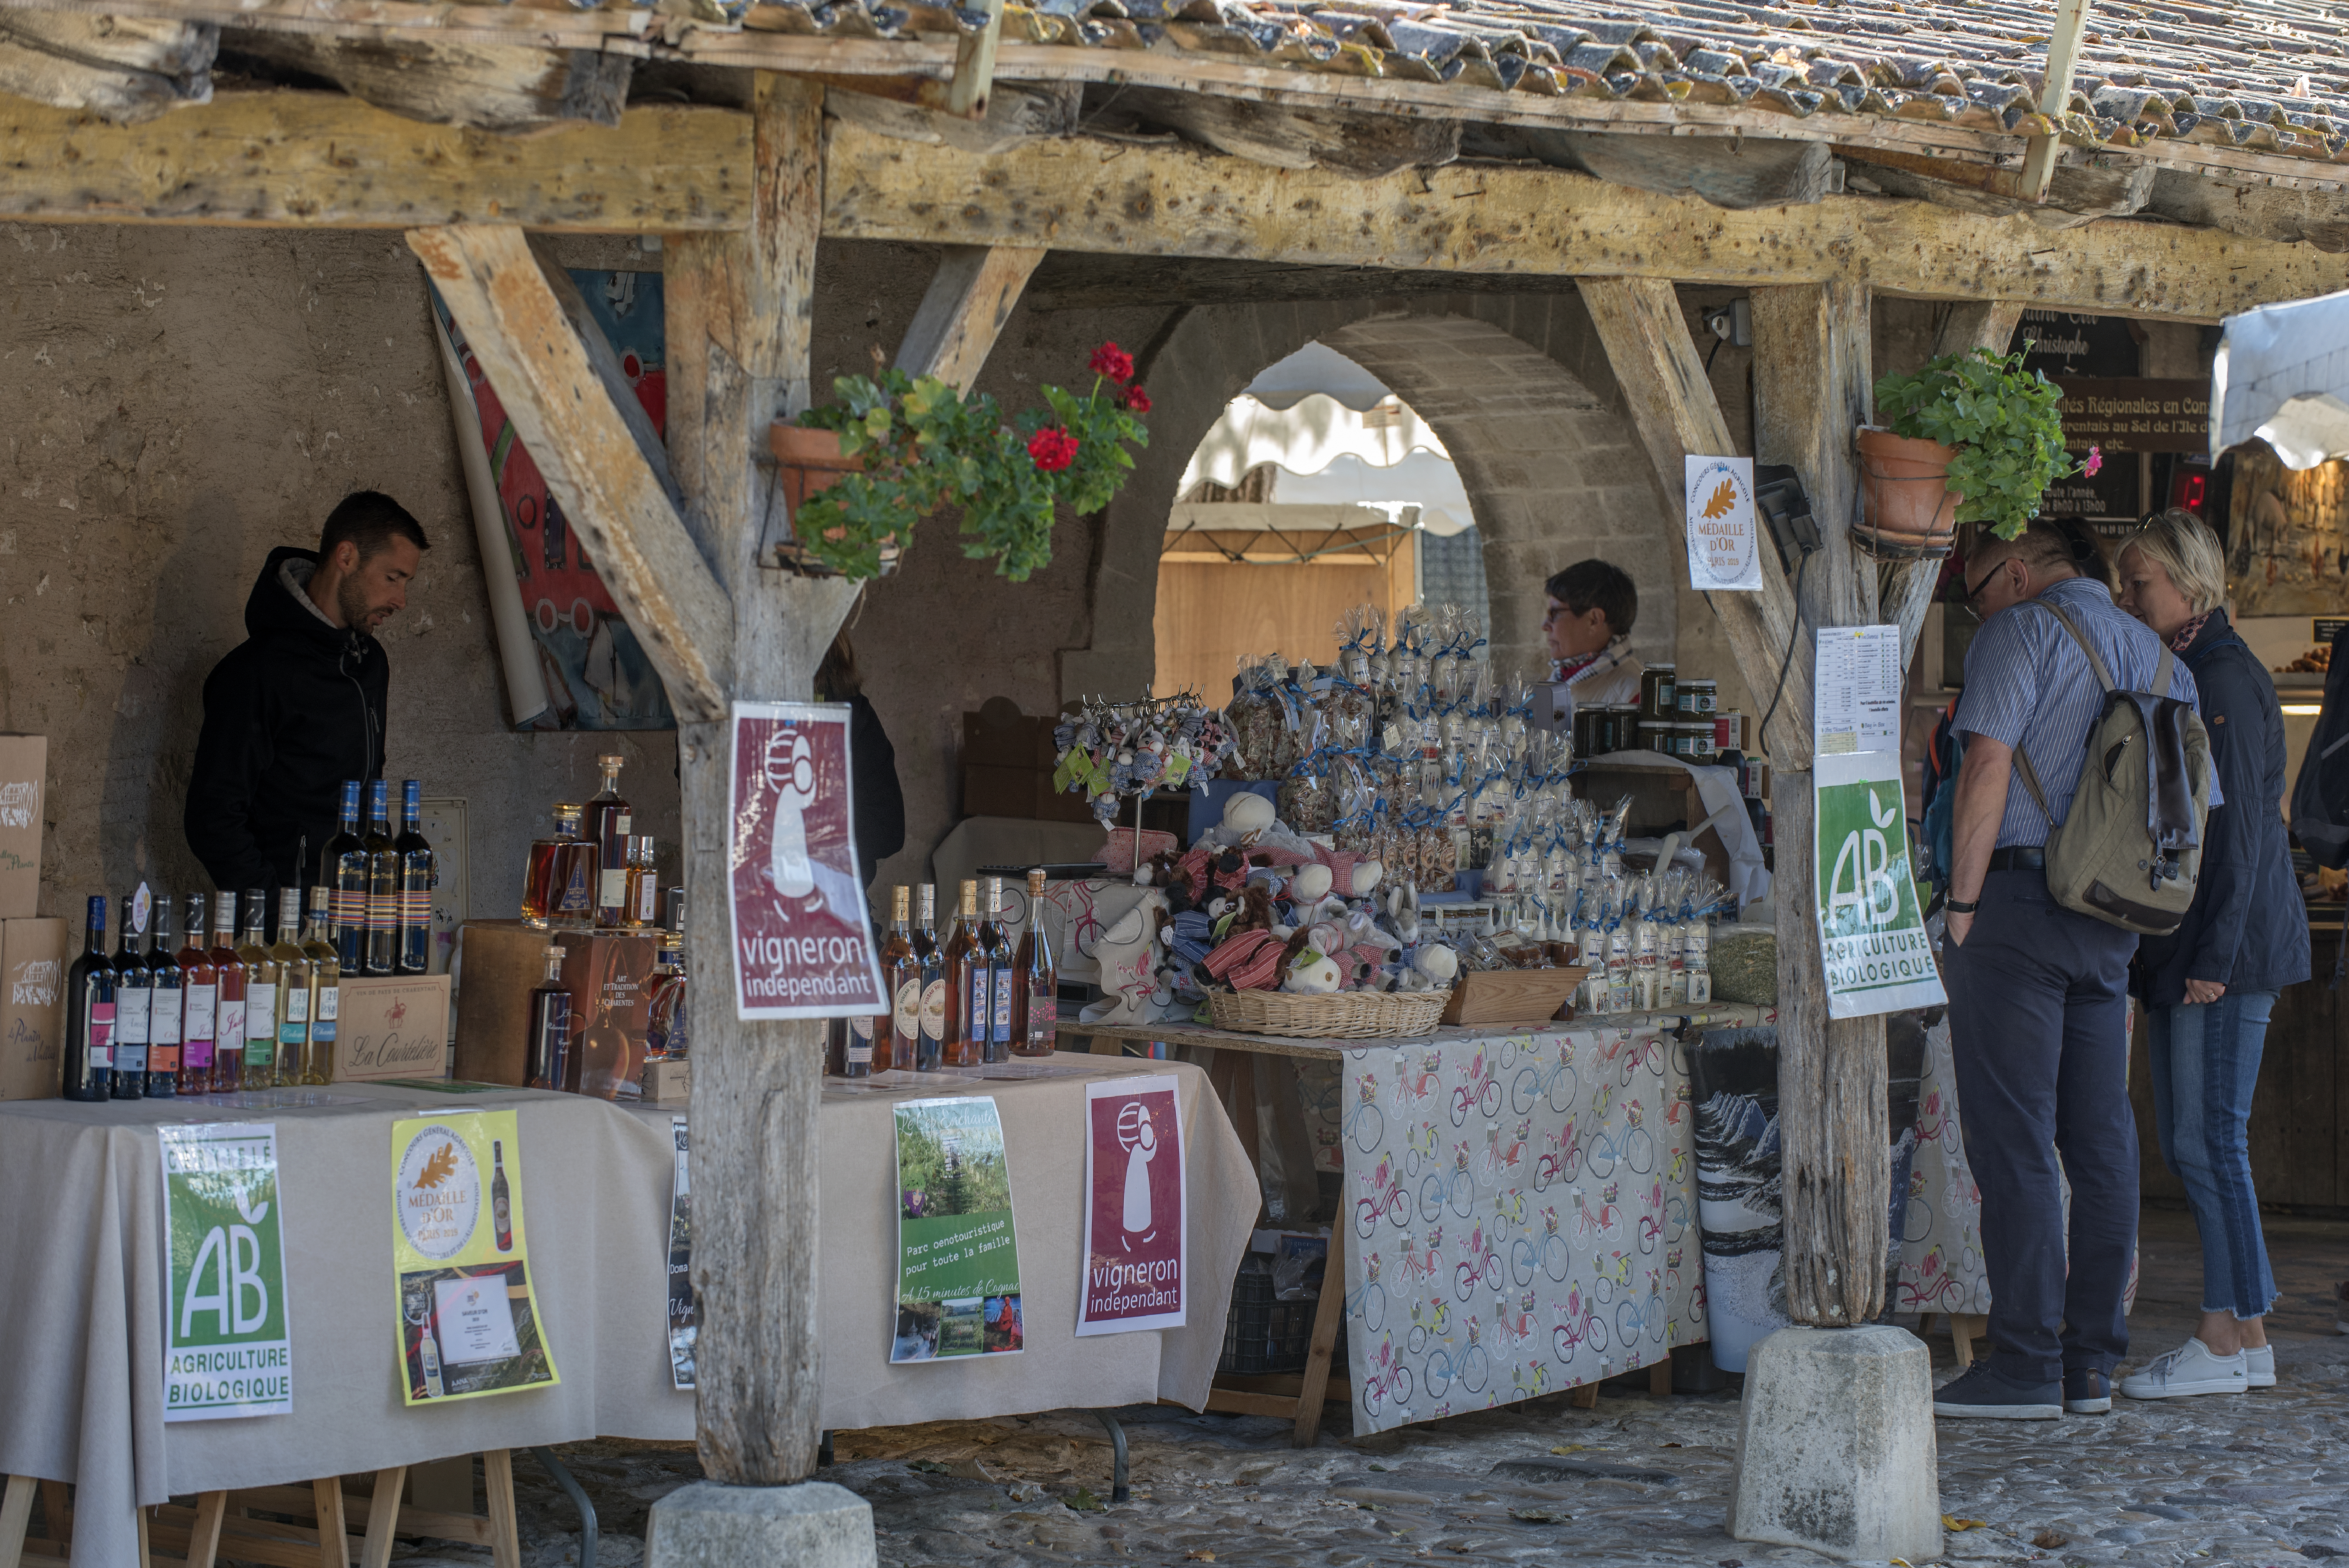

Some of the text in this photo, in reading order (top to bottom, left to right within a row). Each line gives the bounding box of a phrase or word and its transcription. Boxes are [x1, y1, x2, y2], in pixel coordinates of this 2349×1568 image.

[2023, 325, 2089, 363] Christophe
[2055, 397, 2084, 414] lités
[2088, 396, 2160, 417] Régionales
[2164, 401, 2179, 414] en
[2061, 420, 2109, 433] arentais
[2113, 422, 2128, 433] au
[2131, 420, 2150, 433] Sel
[2154, 421, 2169, 433] de
[1691, 461, 1750, 504] CONCOURS GÉNÉRAL AGRICOLE
[2068, 486, 2097, 499] l'année,
[2053, 500, 2073, 512] 8h00
[2083, 500, 2106, 513] 13h00
[1698, 520, 1744, 536] MÉDAILLE
[1707, 551, 1739, 568] PARIS 2019
[1829, 829, 1900, 930] AB
[742, 930, 863, 974] vigneron
[1827, 932, 1927, 962] AGRICULTURE
[1832, 956, 1935, 987] BIOLOGIQUE
[611, 982, 639, 992] TRADITION
[745, 971, 871, 1002] independant
[900, 988, 910, 1004] PINEAU
[924, 989, 935, 1005] PINEAU
[604, 998, 634, 1007] CHARENTES
[348, 1032, 438, 1067] La Courtelière
[900, 1107, 995, 1136] Le Cep Enchanté
[399, 1125, 476, 1176] CONCOURS GÉNÉRAL AGRICOLE
[408, 1190, 467, 1208] MÉDAILLE
[417, 1227, 458, 1243] PARIS 2019
[907, 1219, 1005, 1257] Parc oenotouristique
[1285, 1238, 1323, 1248] Vignerons
[905, 1236, 1010, 1277] pour toute la famille
[180, 1223, 268, 1338] AB
[916, 1286, 930, 1300] 15
[932, 1287, 970, 1300] minutes
[973, 1279, 984, 1295] de
[985, 1278, 1020, 1299] Cognac
[1093, 1258, 1178, 1294] vigneron
[669, 1298, 695, 1324] Vign
[1091, 1287, 1178, 1316] independant
[170, 1347, 288, 1376] AGRICULTURE
[168, 1375, 289, 1404] BIOLOGIQUE
